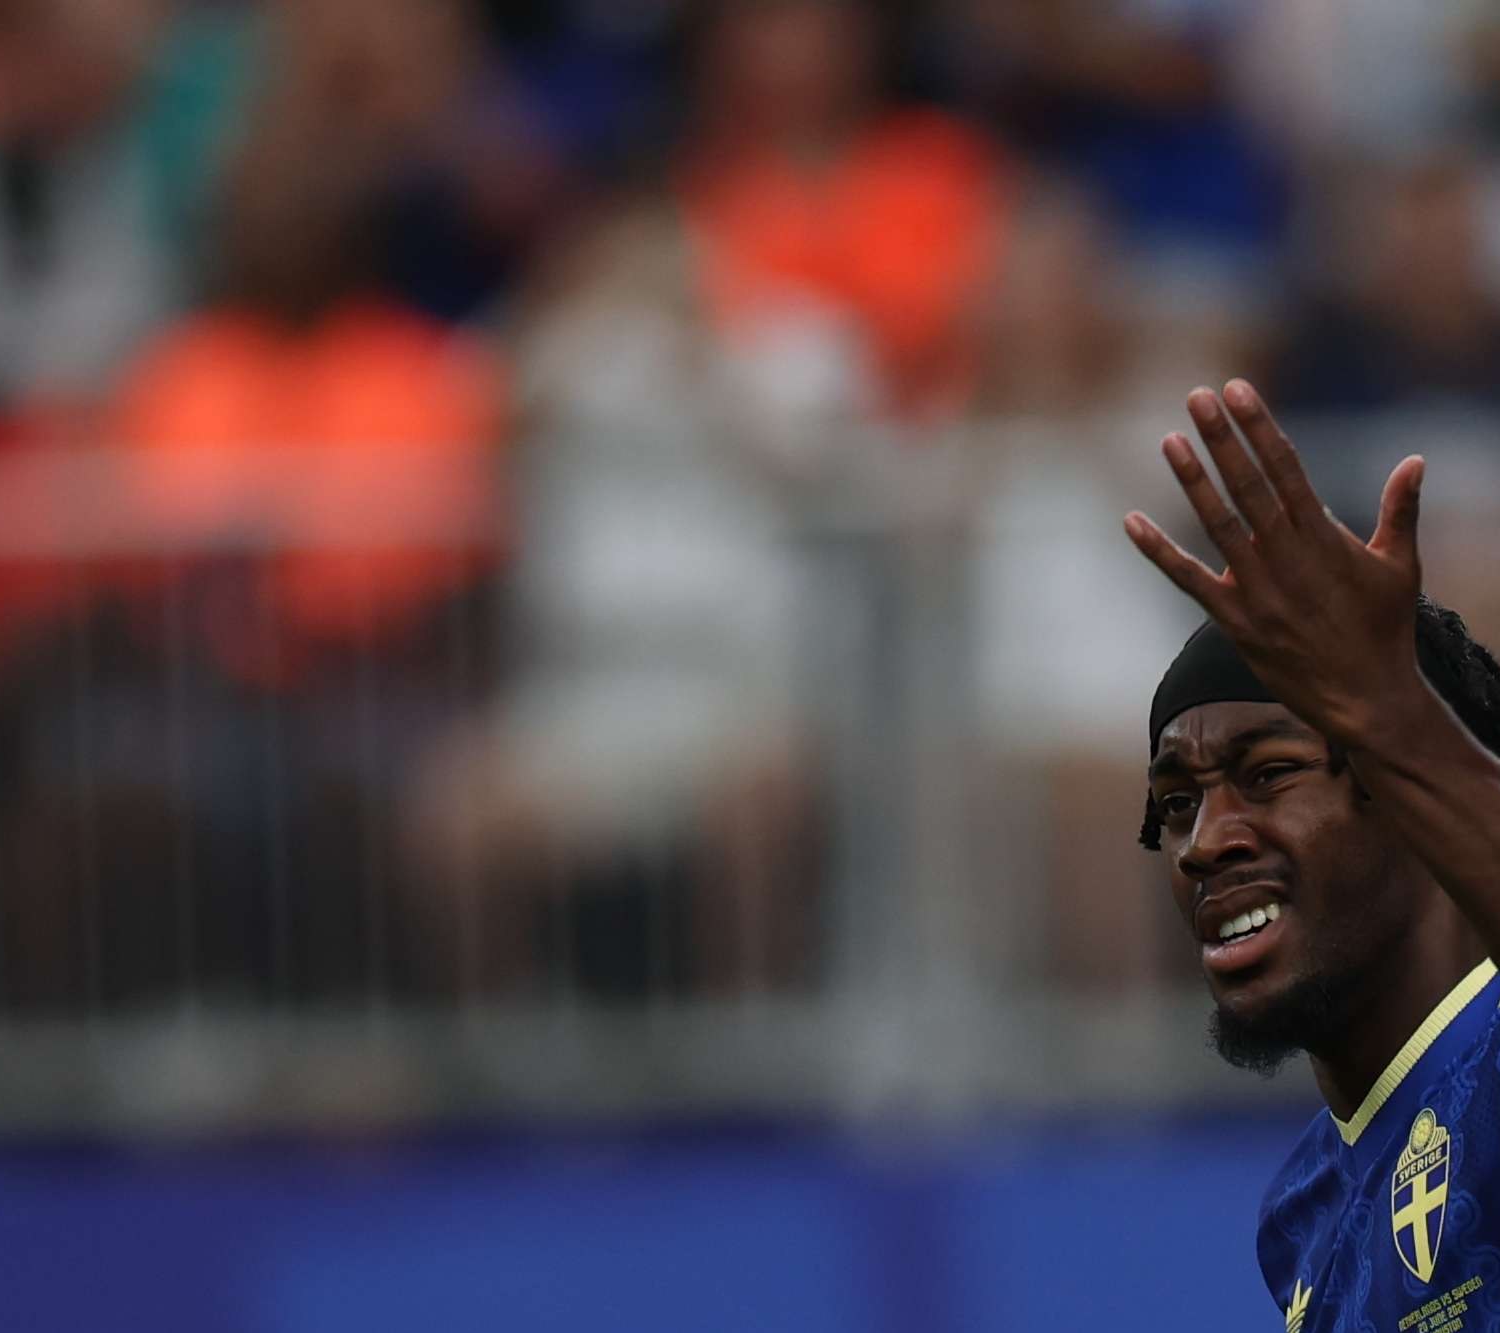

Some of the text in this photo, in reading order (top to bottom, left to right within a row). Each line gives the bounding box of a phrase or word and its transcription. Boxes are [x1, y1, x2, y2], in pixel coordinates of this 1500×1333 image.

[1399, 1147, 1442, 1183] SVERIGE
[1418, 1321, 1428, 1333] 20
[1446, 1299, 1468, 1318] 2026
[1440, 1292, 1452, 1306] VS
